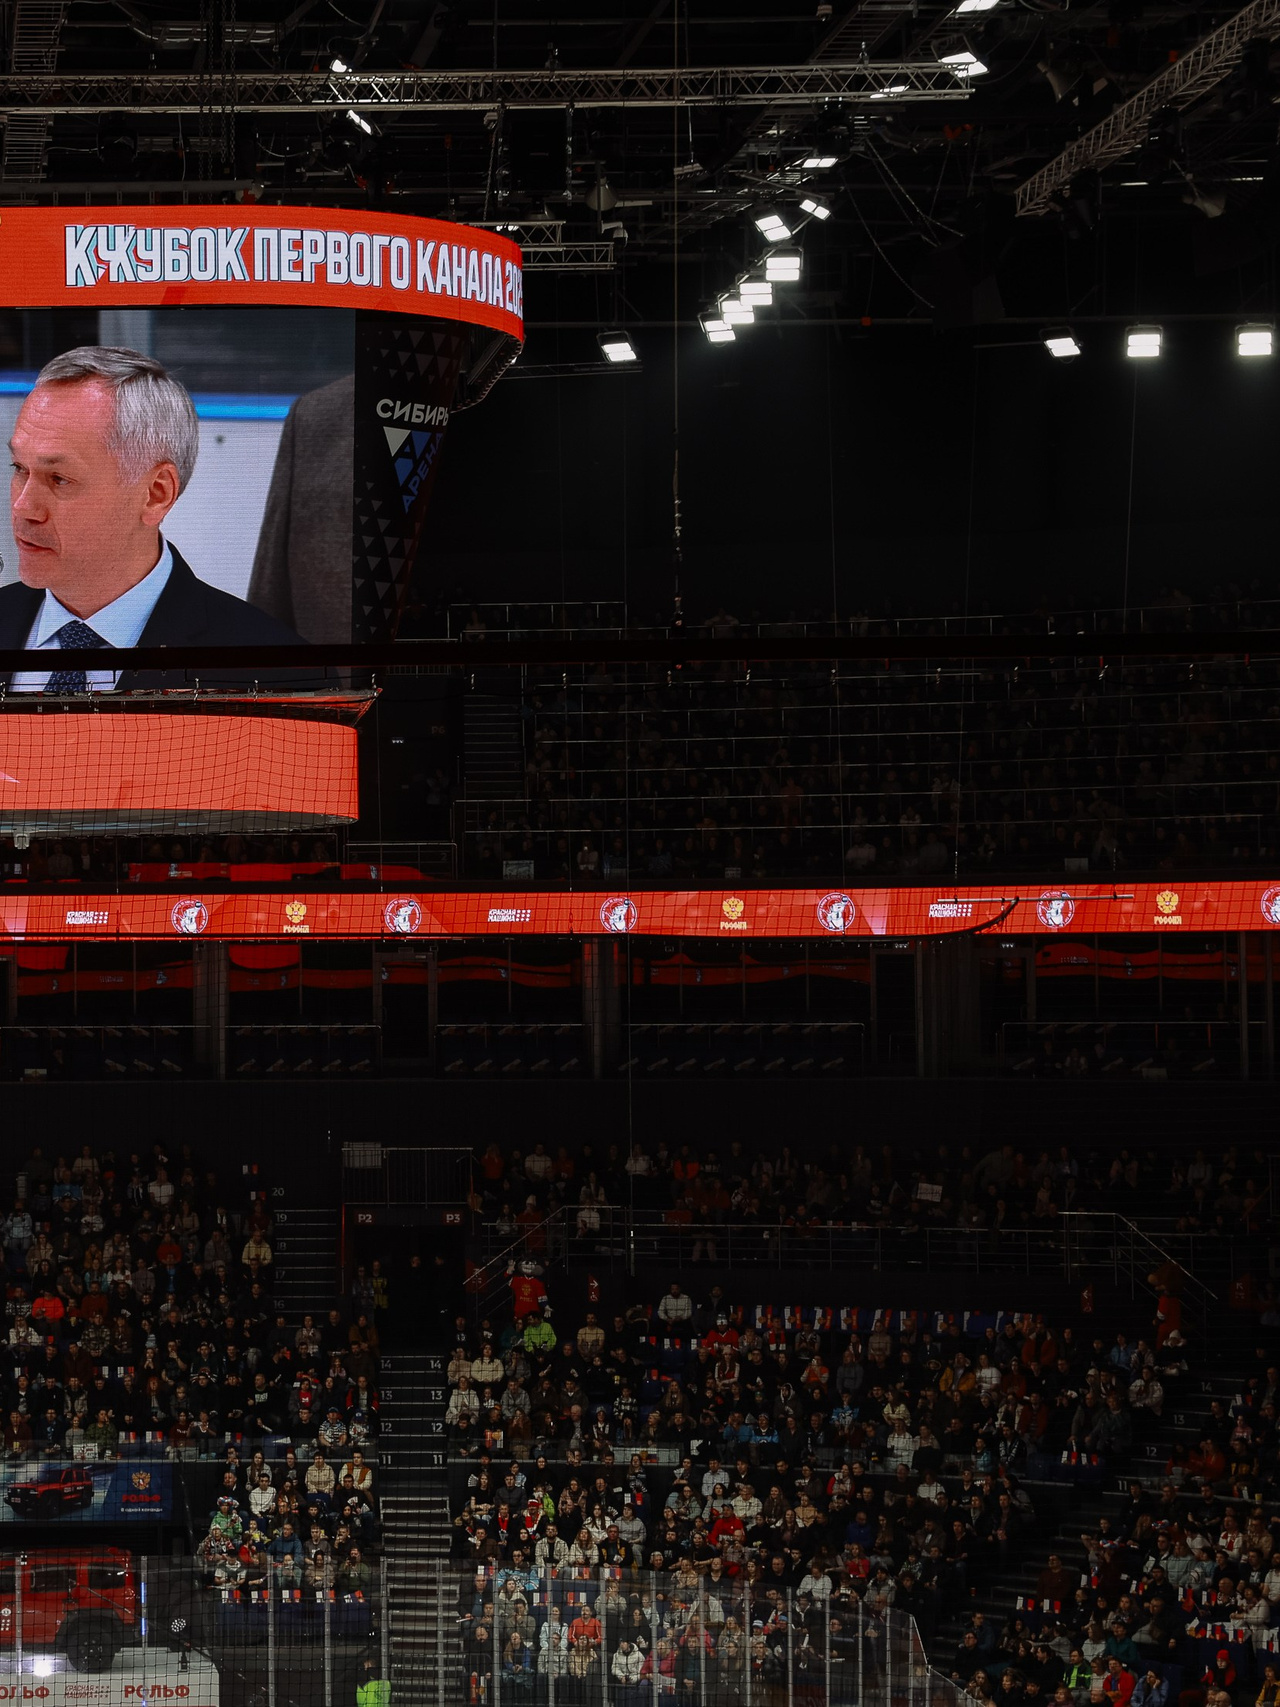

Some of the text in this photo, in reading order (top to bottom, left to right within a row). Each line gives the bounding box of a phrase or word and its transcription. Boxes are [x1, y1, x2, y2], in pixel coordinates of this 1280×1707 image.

[252, 227, 411, 291] ПЕРВОГО
[416, 239, 504, 309] КАНАЛА
[375, 398, 449, 426] СИБИРЬ
[402, 432, 444, 515] АРЕНА
[357, 1213, 373, 1223] P2
[380, 1359, 392, 1369] 14
[430, 1359, 442, 1369] 14
[380, 1390, 393, 1400] 13
[431, 1390, 443, 1400] 13
[380, 1422, 393, 1432] 12
[431, 1422, 443, 1432] 12
[124, 1685, 190, 1699] РОЛЬФ
